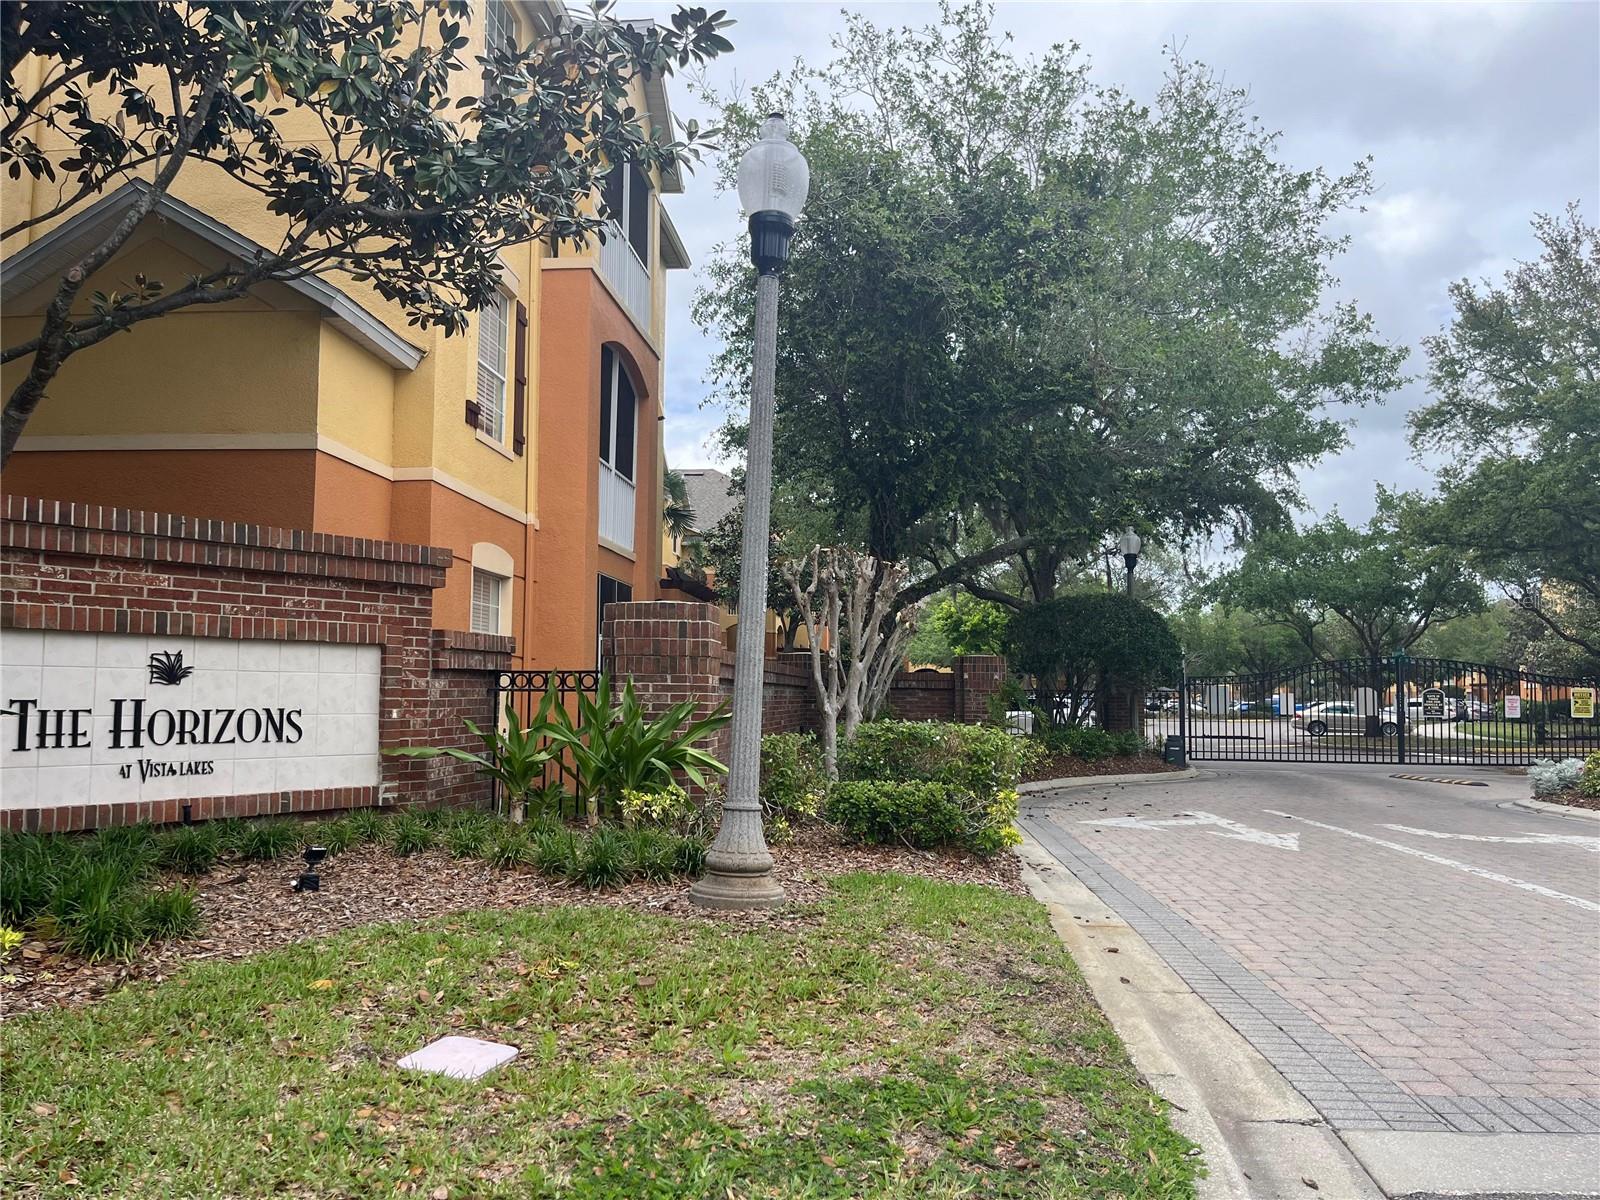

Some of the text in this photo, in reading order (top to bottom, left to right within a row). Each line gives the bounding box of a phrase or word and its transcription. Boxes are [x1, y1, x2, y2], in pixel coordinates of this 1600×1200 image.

[0, 699, 303, 751] THE HORIZONS
[119, 758, 214, 784] AT VISTA LAKES
